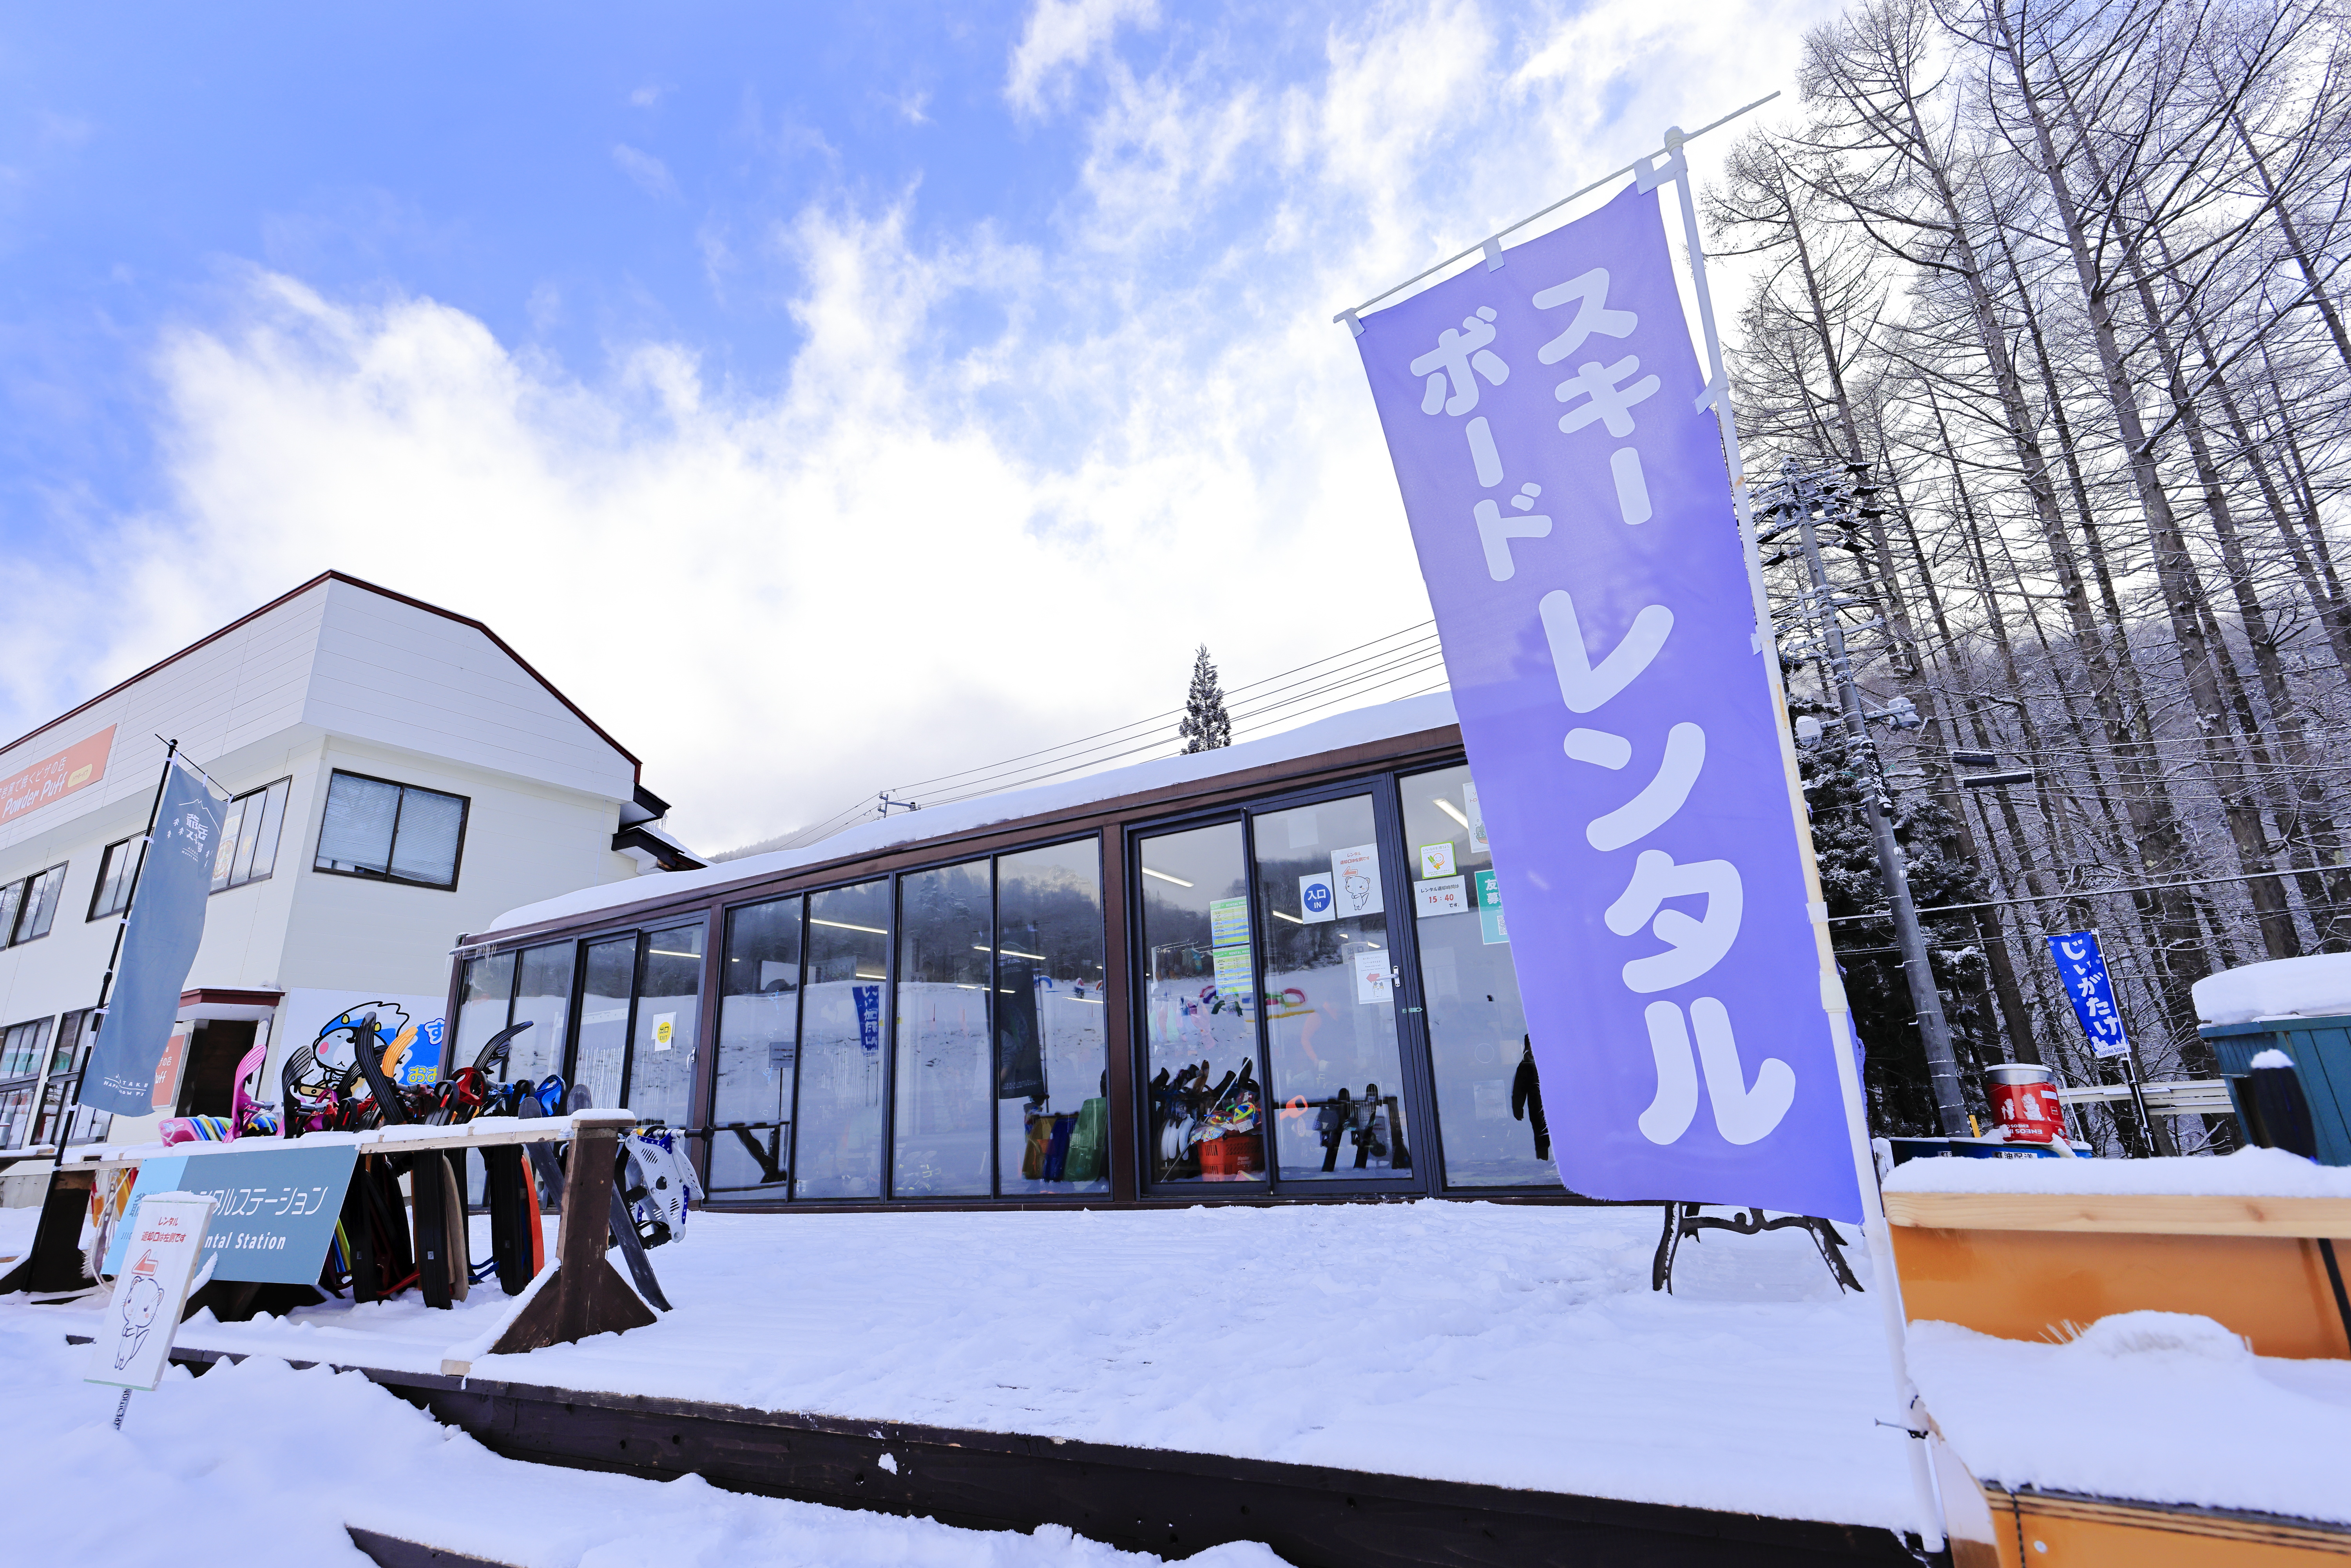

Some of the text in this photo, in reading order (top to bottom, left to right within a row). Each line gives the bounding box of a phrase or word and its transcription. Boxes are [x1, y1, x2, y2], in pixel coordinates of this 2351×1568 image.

[1532, 268, 1661, 525] スキー
[1411, 306, 1552, 581] ボード
[2, 771, 68, 818] Powder Puff
[1340, 856, 1370, 865] 返却口は左側です
[1539, 590, 1796, 1145] レンタル
[1421, 884, 1459, 893] レンタル返却時間は
[1485, 879, 1499, 891] 友
[1307, 889, 1326, 901] 入口
[659, 1026, 669, 1034] 出口
[155, 1071, 167, 1084] uff
[200, 1186, 328, 1215] タルステーション
[158, 1217, 179, 1226] レンタル
[141, 1231, 187, 1243] 返却口は左側です
[204, 1232, 286, 1250] ntal Station
[113, 1388, 131, 1430] XPEDITION
